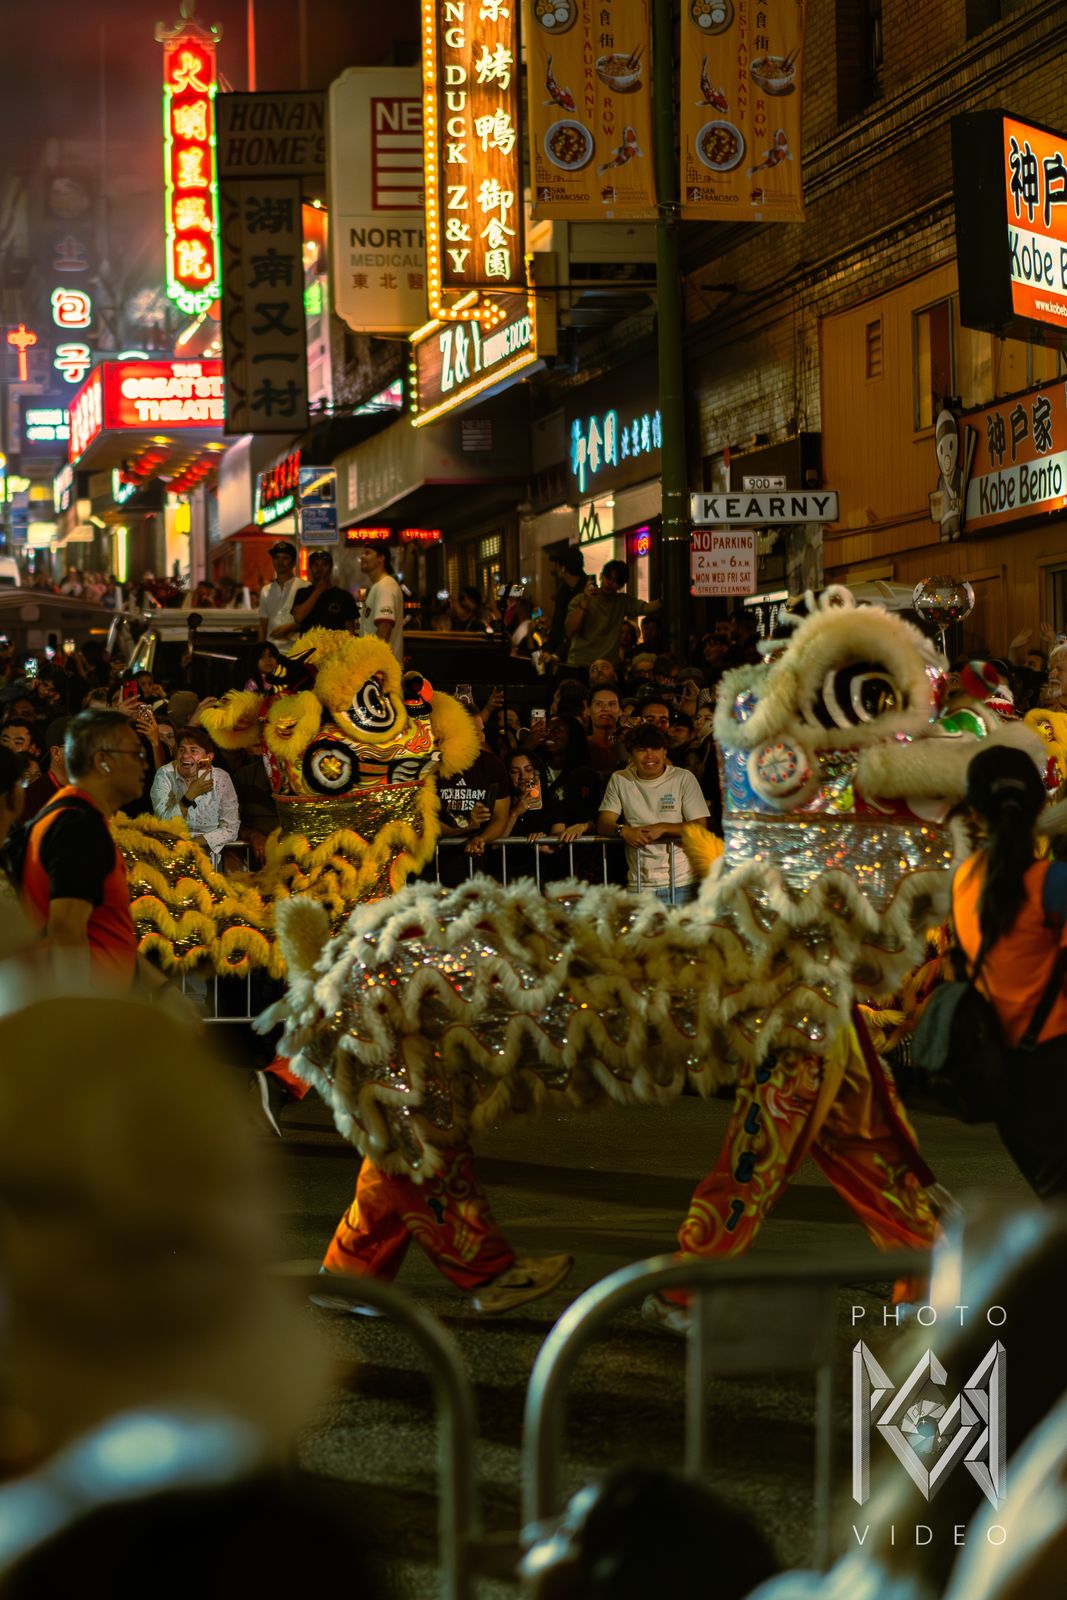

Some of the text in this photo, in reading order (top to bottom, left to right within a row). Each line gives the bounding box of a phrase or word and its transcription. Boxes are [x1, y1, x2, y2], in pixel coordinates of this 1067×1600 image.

[599, 0, 614, 48] 食街
[228, 101, 325, 131] HUNAN
[445, 65, 468, 164] DUCK
[602, 97, 615, 136] ROW
[754, 100, 767, 138] ROW
[701, 194, 739, 202] FRANCISCO
[445, 185, 471, 273] Z&Y
[350, 254, 423, 267] MEDICAL
[1009, 231, 1054, 287] Kobe
[245, 196, 300, 418] 湖南又一村
[749, 479, 770, 489] 900
[979, 460, 1062, 515] Kobe Bento
[704, 496, 830, 518] KEARNY
[693, 533, 753, 550] NO PARKING
[698, 556, 704, 568] 2
[729, 556, 737, 567] 6
[695, 572, 751, 583] MON WED FRI SAT
[440, 788, 486, 800] TEXAS A&M
